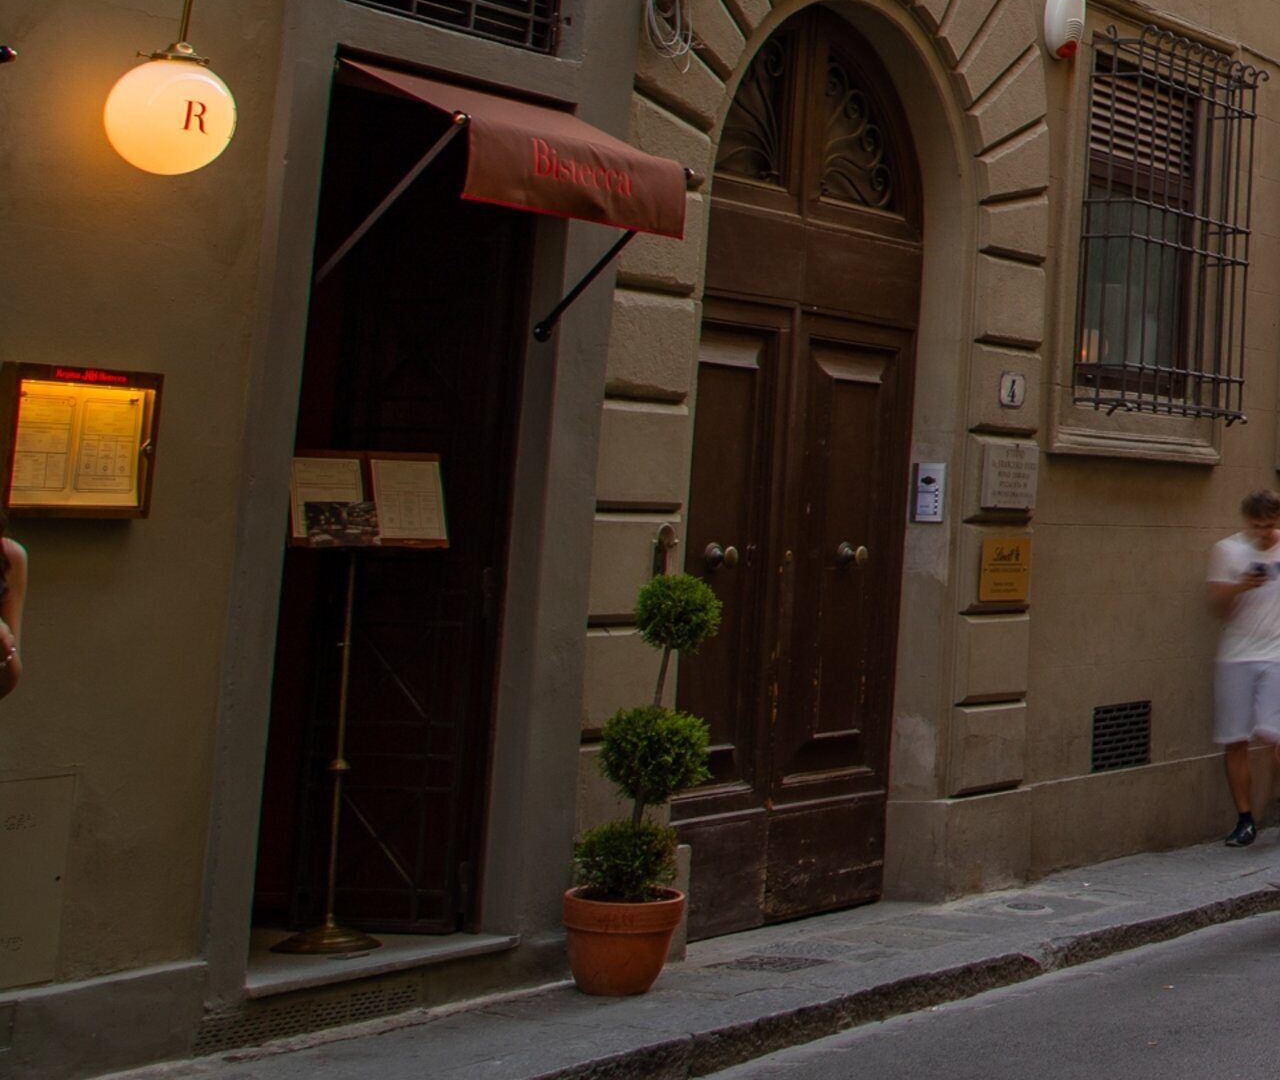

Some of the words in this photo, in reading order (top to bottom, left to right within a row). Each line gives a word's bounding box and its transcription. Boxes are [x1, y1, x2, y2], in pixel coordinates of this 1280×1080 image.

[180, 100, 208, 135] R
[531, 137, 633, 198] Bistecca
[1007, 379, 1017, 403] 4
